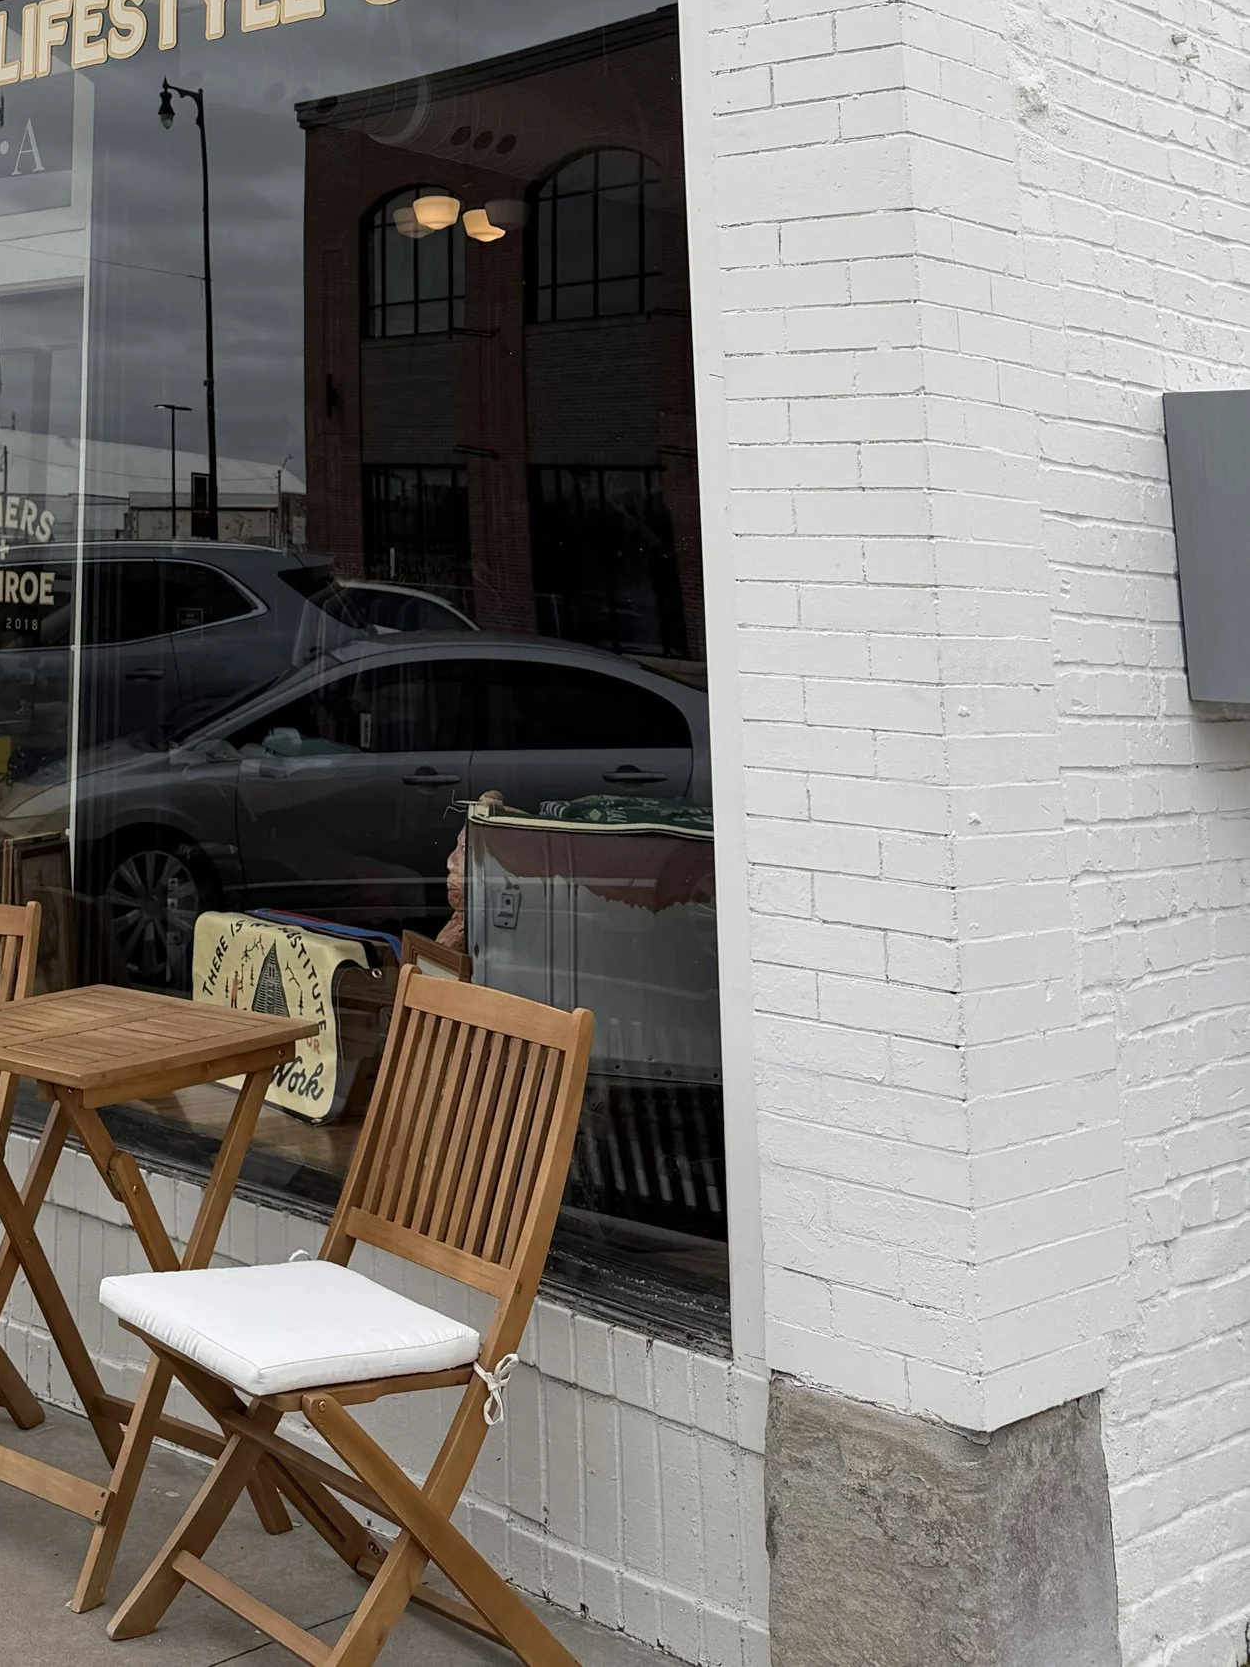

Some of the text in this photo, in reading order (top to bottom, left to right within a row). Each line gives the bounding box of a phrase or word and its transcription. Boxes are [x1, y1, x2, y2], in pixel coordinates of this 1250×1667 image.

[5, 617, 39, 631] 2018
[202, 936, 229, 997] THERE
[230, 919, 246, 937] IS
